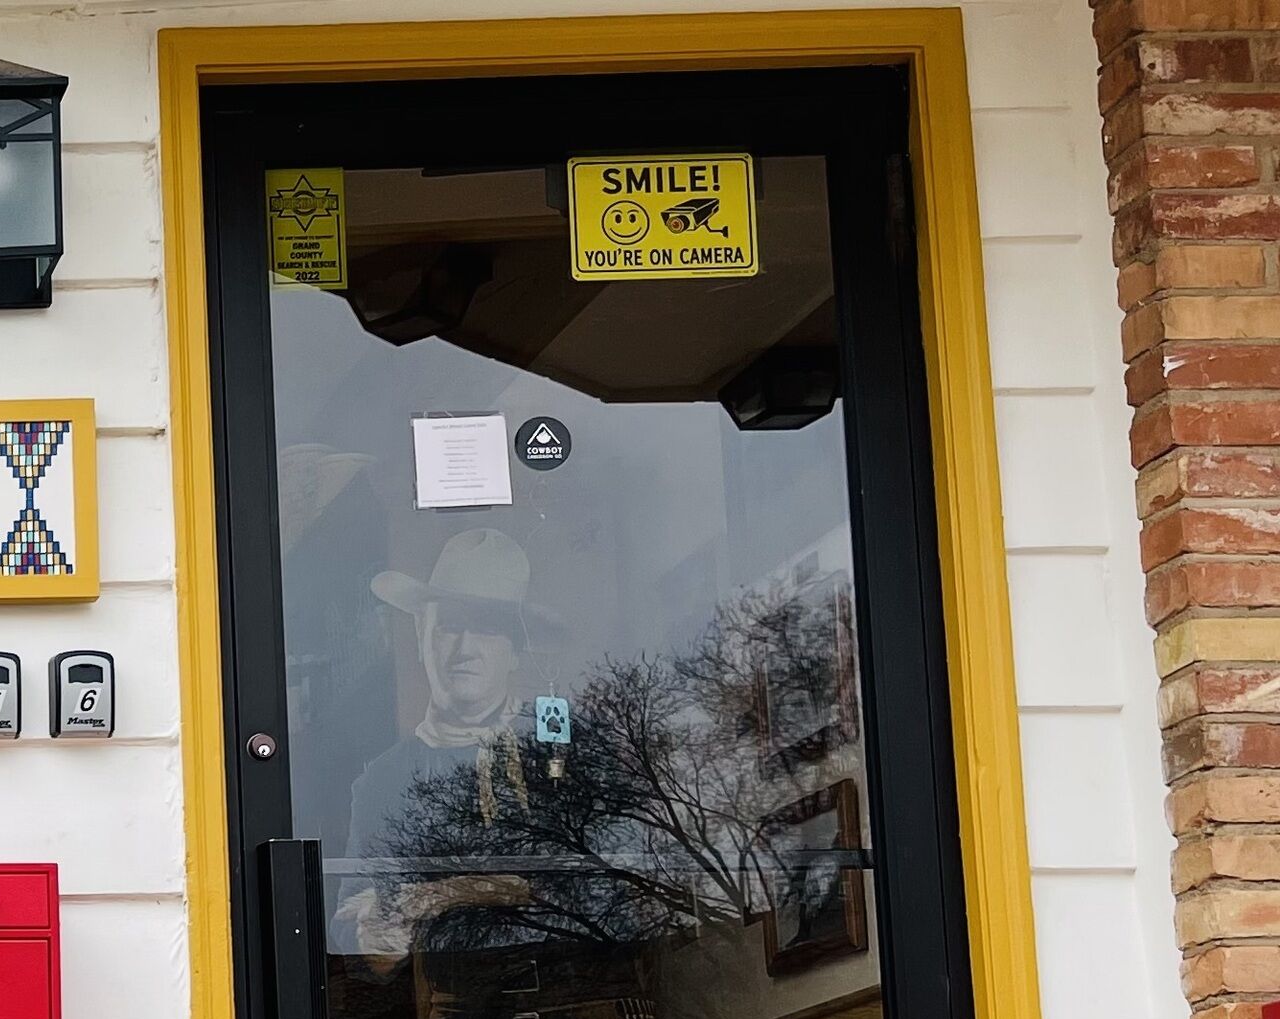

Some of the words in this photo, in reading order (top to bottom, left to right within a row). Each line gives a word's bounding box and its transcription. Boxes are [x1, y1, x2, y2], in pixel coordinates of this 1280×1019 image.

[602, 165, 721, 195] SMILE!
[585, 248, 643, 267] YOU'RE
[649, 248, 672, 265] ON
[680, 247, 745, 265] CAMERA
[295, 271, 320, 281] 2022
[80, 689, 97, 712] 6
